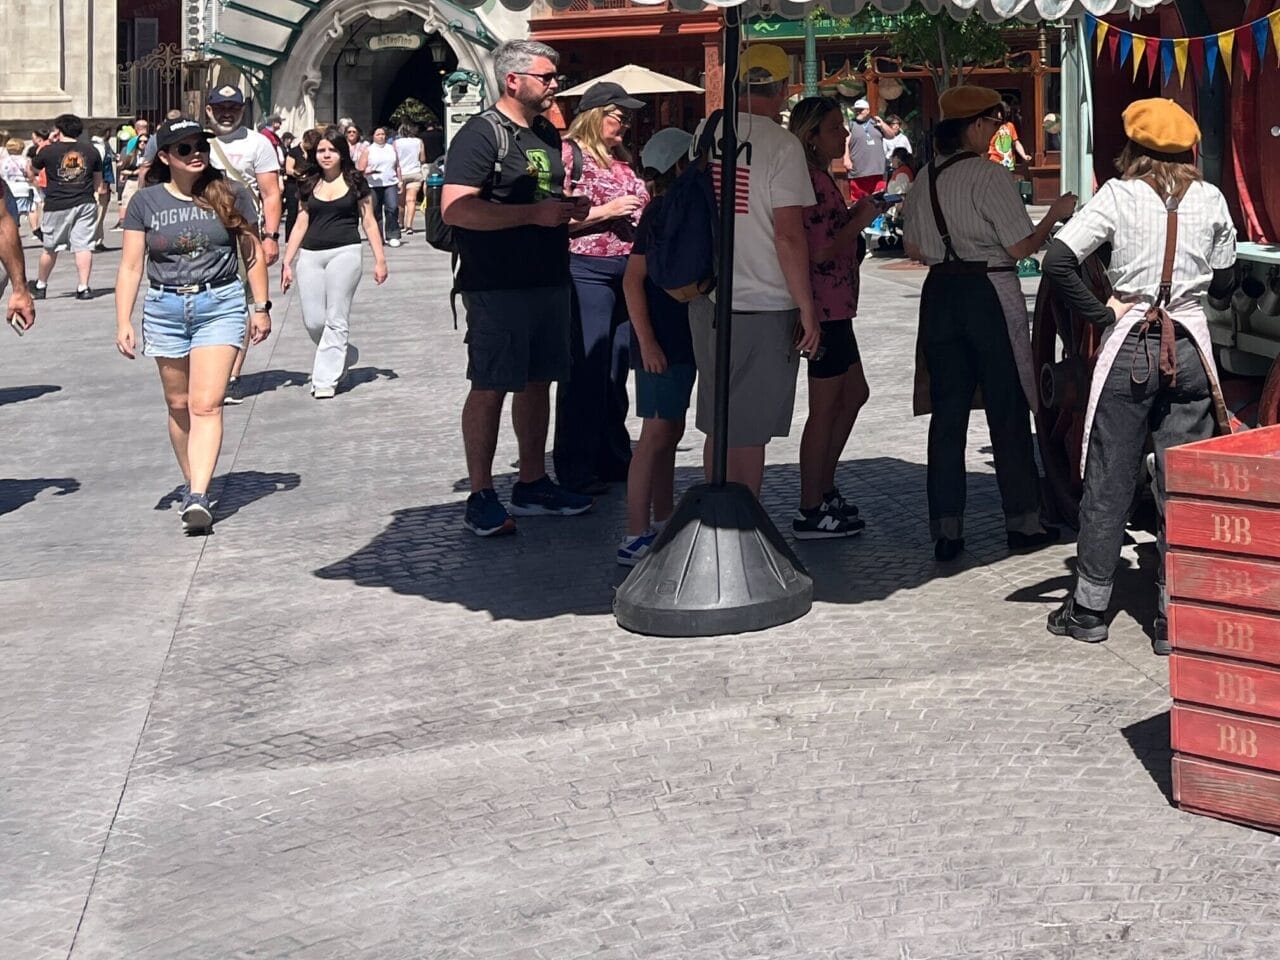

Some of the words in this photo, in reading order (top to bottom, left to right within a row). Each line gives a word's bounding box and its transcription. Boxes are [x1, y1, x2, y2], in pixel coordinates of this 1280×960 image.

[150, 205, 218, 231] HOGWART
[1209, 460, 1251, 492] BB
[1210, 512, 1253, 546] BB
[1214, 618, 1255, 653] BB
[1215, 670, 1257, 706] BB
[1217, 723, 1259, 759] BB
